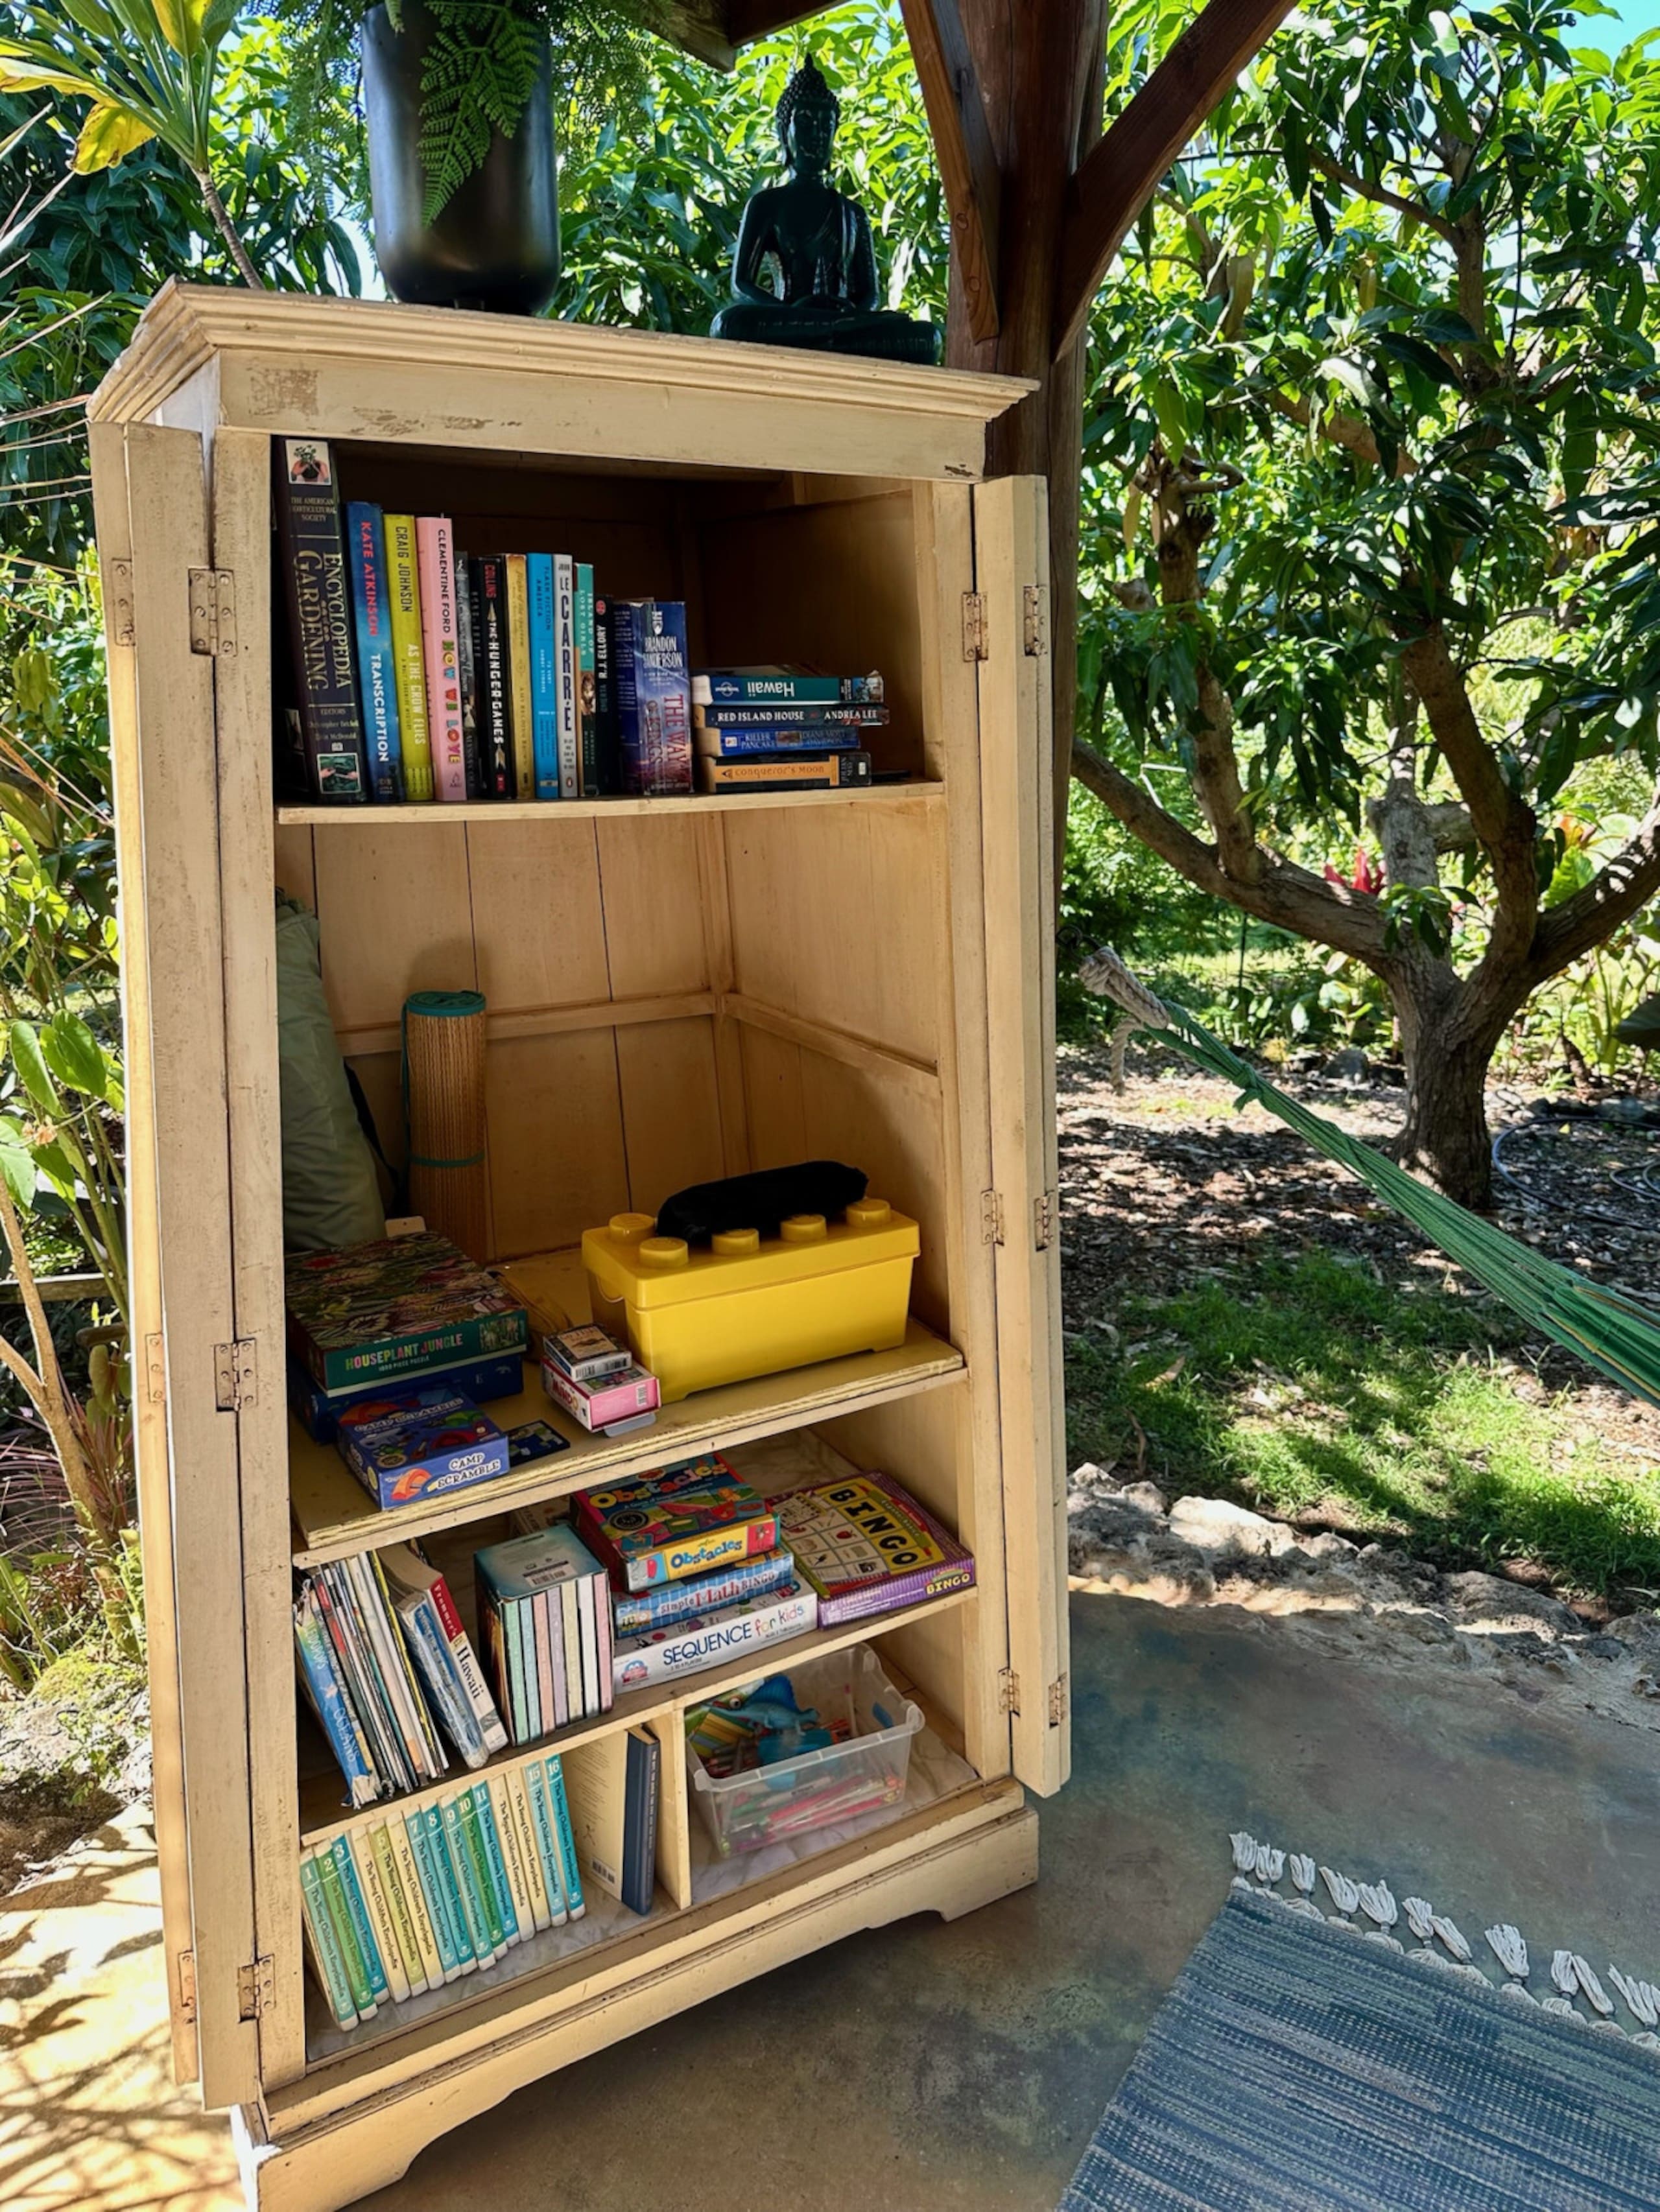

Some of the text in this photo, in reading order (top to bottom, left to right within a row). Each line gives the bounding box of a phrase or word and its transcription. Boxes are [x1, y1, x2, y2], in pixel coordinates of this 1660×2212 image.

[304, 497, 334, 506] AMERICAN
[361, 521, 379, 637] KATE ATKINSON
[396, 526, 412, 613] CRAIG JOHNSON
[438, 528, 451, 633] CLEMENTINE FORD
[484, 564, 497, 599] COLLINS
[560, 576, 569, 591] LE
[294, 549, 329, 690] GARDENING
[324, 552, 352, 688] ENCYCLOPEDIA
[588, 639, 595, 654] OF
[596, 624, 608, 660] ELLORY
[644, 635, 678, 652] BRANDON
[643, 652, 684, 668] SANDERSON
[488, 622, 504, 745] THE HUNGER GAMES
[747, 681, 796, 698] Hawaii
[407, 644, 425, 746] AS THE CROW FLIES
[443, 640, 461, 764] HOW WE LOVE
[370, 653, 389, 762] TRANSCRIPTION
[663, 694, 685, 727] THE
[717, 711, 805, 722] RED ISLAND HOUSE
[824, 709, 878, 720] ANDREA LEE
[647, 715, 663, 764] KINGS
[667, 729, 687, 764] WAY
[741, 741, 776, 750] PANCAKE
[744, 733, 772, 742] KILLER
[346, 1334, 464, 1371] HOUSEPLANT JUNGLE
[355, 1398, 464, 1432] CAMP SCRAMBLE
[450, 1454, 484, 1470] CAMP
[437, 1461, 500, 1488] SCRAMBLE
[589, 1462, 728, 1509] Obstacles
[829, 1488, 918, 1564] BINGO
[670, 1540, 742, 1568] Obstacles
[661, 1572, 776, 1614] Simple Math BINGO
[927, 1573, 971, 1595] BINGO
[433, 1584, 458, 1637] Frommer's
[663, 1622, 752, 1665] SEQUENCE
[755, 1618, 776, 1637] for
[777, 1605, 804, 1623] kids
[456, 1645, 484, 1699] Hawaii
[333, 1707, 359, 1763] OCEANS
[528, 1769, 541, 1782] 15
[549, 1761, 560, 1775] 16
[477, 1790, 486, 1802] 11
[515, 1793, 525, 1807] The
[534, 1790, 544, 1804] The
[554, 1783, 563, 1797] The
[447, 1809, 456, 1823] 9
[458, 1797, 471, 1813] 10
[482, 1809, 492, 1823] The
[499, 1802, 508, 1815] The
[536, 1802, 547, 1823] Young
[410, 1820, 418, 1833] 7
[429, 1813, 438, 1828] 8
[501, 1814, 512, 1835] Young
[517, 1806, 528, 1827] Young
[434, 1835, 445, 1849] The
[453, 1829, 463, 1844] The
[484, 1822, 496, 1843] Young
[335, 1844, 345, 1858] 3
[401, 1848, 411, 1862] The
[416, 1842, 427, 1856] The
[437, 1847, 449, 1869] Young
[455, 1842, 468, 1864] Young
[324, 1857, 334, 1871] 2
[365, 1861, 376, 1876] The
[384, 1853, 394, 1868] The
[404, 1860, 416, 1883] Young
[420, 1855, 432, 1877] Young
[305, 1867, 313, 1879] 1
[387, 1866, 399, 1888] Young
[527, 1857, 541, 1898] Encyclopedia
[545, 1853, 559, 1894] Encyclopedia
[311, 1889, 322, 1903] The
[368, 1874, 381, 1896] Young
[495, 1873, 510, 1915] Encyclopedia
[510, 1865, 525, 1907] Encyclopedia
[314, 1901, 327, 1924] Young
[449, 1899, 466, 1941] Encyclopedia
[467, 1895, 484, 1938] Encyclopedia
[416, 1912, 433, 1955] Encyclopedia
[432, 1907, 449, 1949] Encyclopedia
[381, 1926, 399, 1970] Encyclopedia
[399, 1918, 416, 1961] Encyclopedia
[328, 1954, 346, 1997] Encyclopedia
